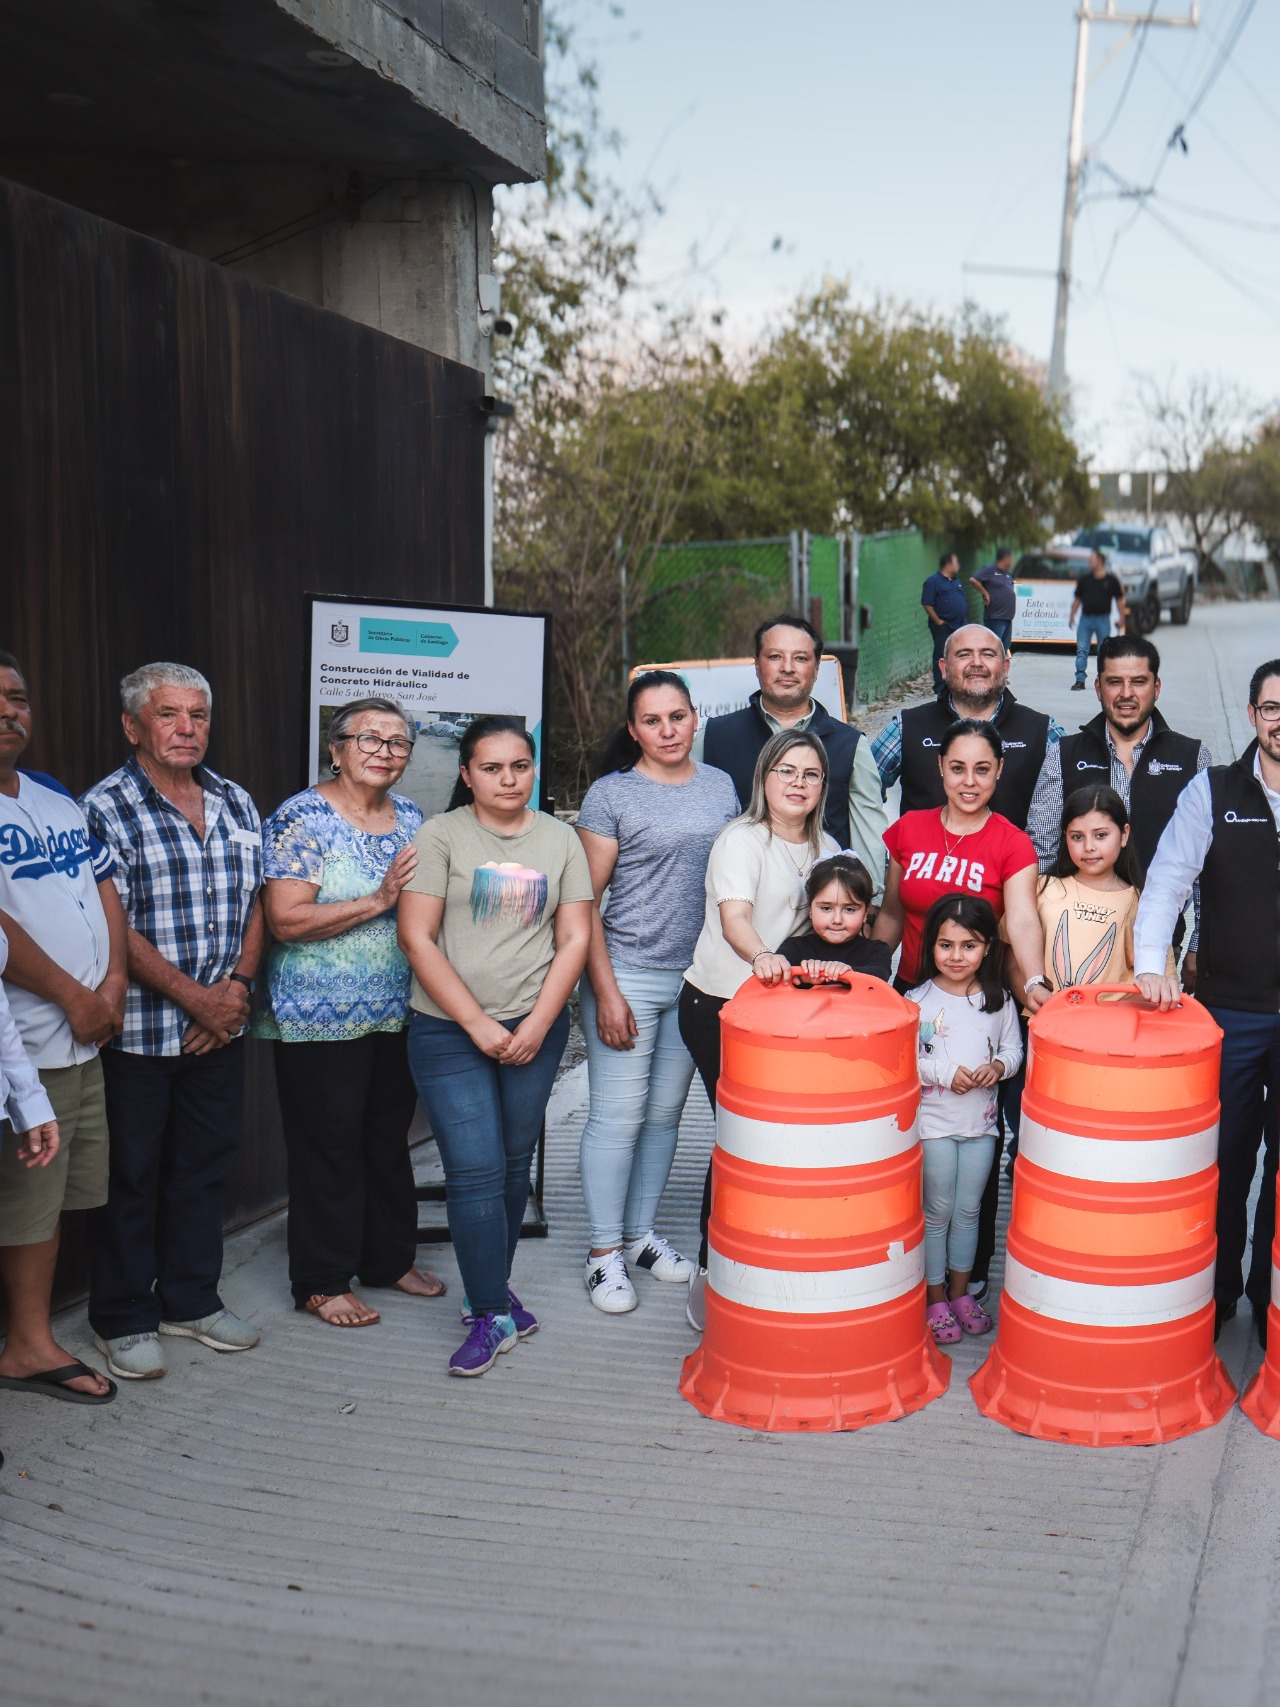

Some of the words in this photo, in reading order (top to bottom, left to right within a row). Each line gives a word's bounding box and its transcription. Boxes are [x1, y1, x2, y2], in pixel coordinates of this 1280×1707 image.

[1025, 598, 1045, 608] Este
[1022, 609, 1033, 618] de
[1034, 619, 1066, 628] impues
[320, 663, 392, 675] Construcción
[395, 668, 409, 676] de
[412, 668, 454, 679] Vialidad
[457, 672, 470, 680] de
[320, 675, 370, 686] Concreto
[373, 678, 428, 689] Hidráulico
[319, 687, 344, 697] Calle
[345, 688, 352, 697] 5
[352, 688, 365, 698] de
[397, 691, 415, 700] San
[416, 692, 437, 702] José
[903, 851, 985, 893] PARIS
[1073, 901, 1117, 917] LOONEY
[1075, 909, 1108, 924] TUNES
